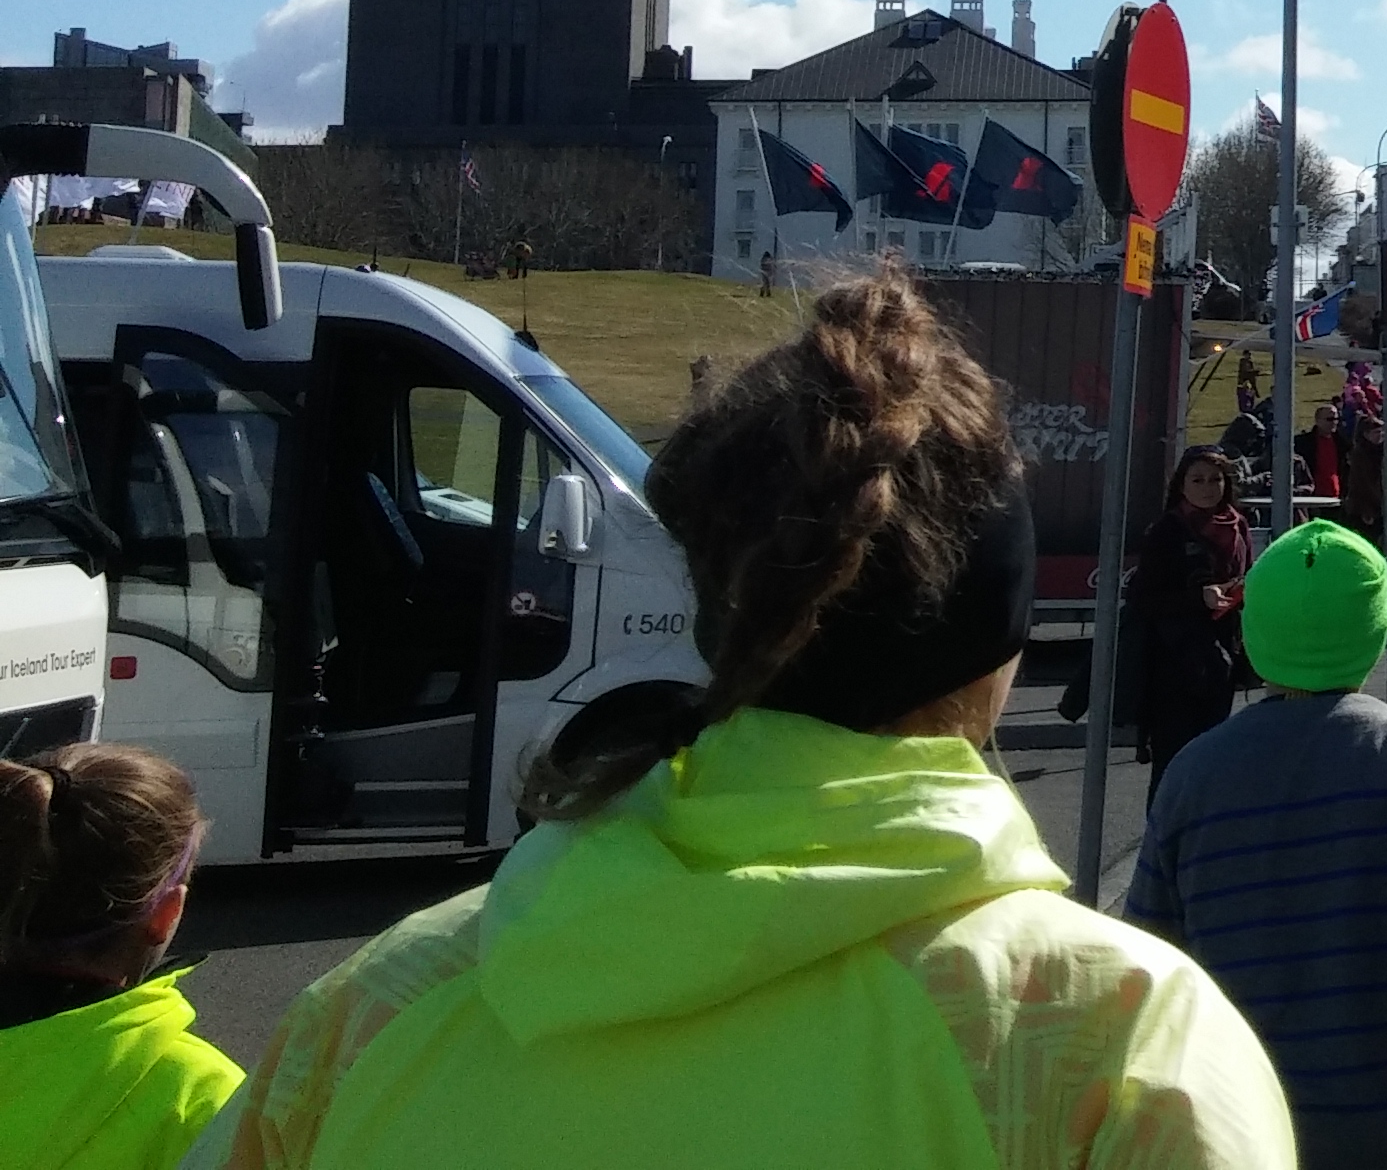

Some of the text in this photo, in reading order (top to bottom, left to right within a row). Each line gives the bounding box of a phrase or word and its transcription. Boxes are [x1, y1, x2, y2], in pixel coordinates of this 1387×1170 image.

[639, 613, 685, 634] 540
[10, 654, 48, 678] Iceland
[50, 652, 69, 671] Tour
[70, 647, 96, 670] Expert
